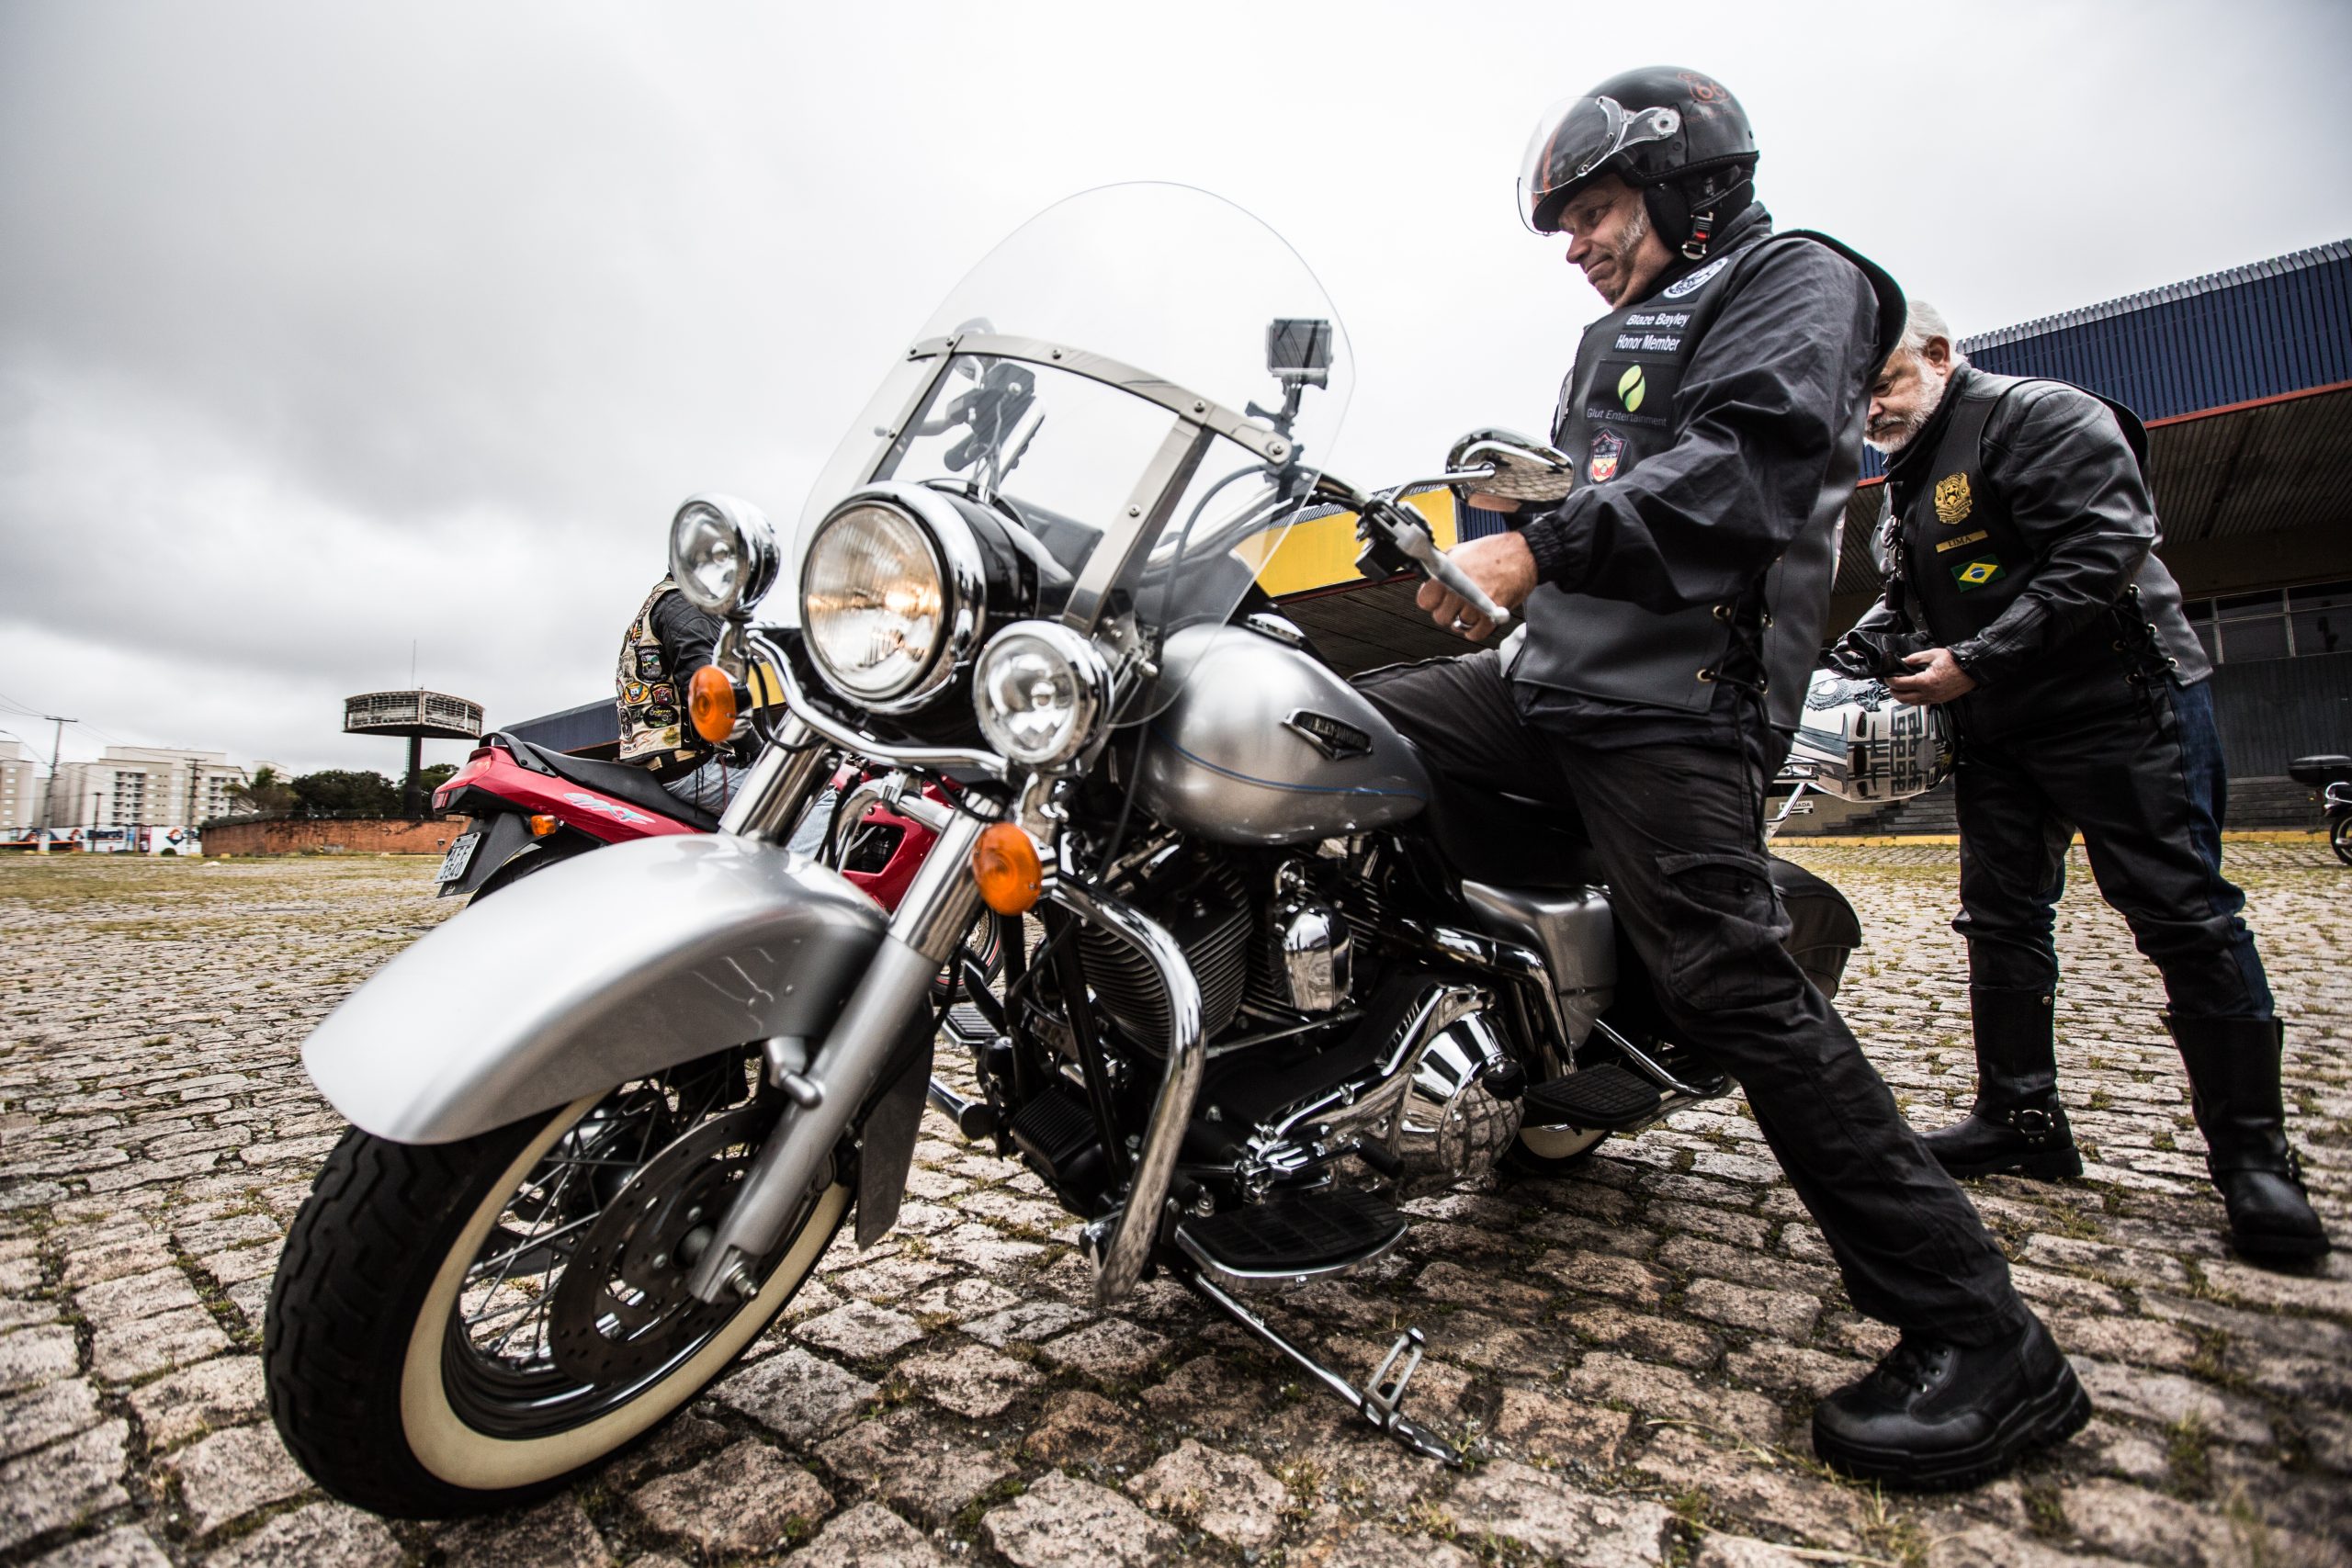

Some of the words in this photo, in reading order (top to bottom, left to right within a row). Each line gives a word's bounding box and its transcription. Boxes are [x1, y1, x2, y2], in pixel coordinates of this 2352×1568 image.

[1626, 314, 1656, 325] Blaze
[1655, 312, 1690, 328] Bayley
[1615, 333, 1643, 350] Honor
[1642, 334, 1681, 352] Member
[1587, 408, 1605, 419] Glut
[1605, 410, 1668, 426] Entertainment
[1948, 536, 1973, 547] LIMA
